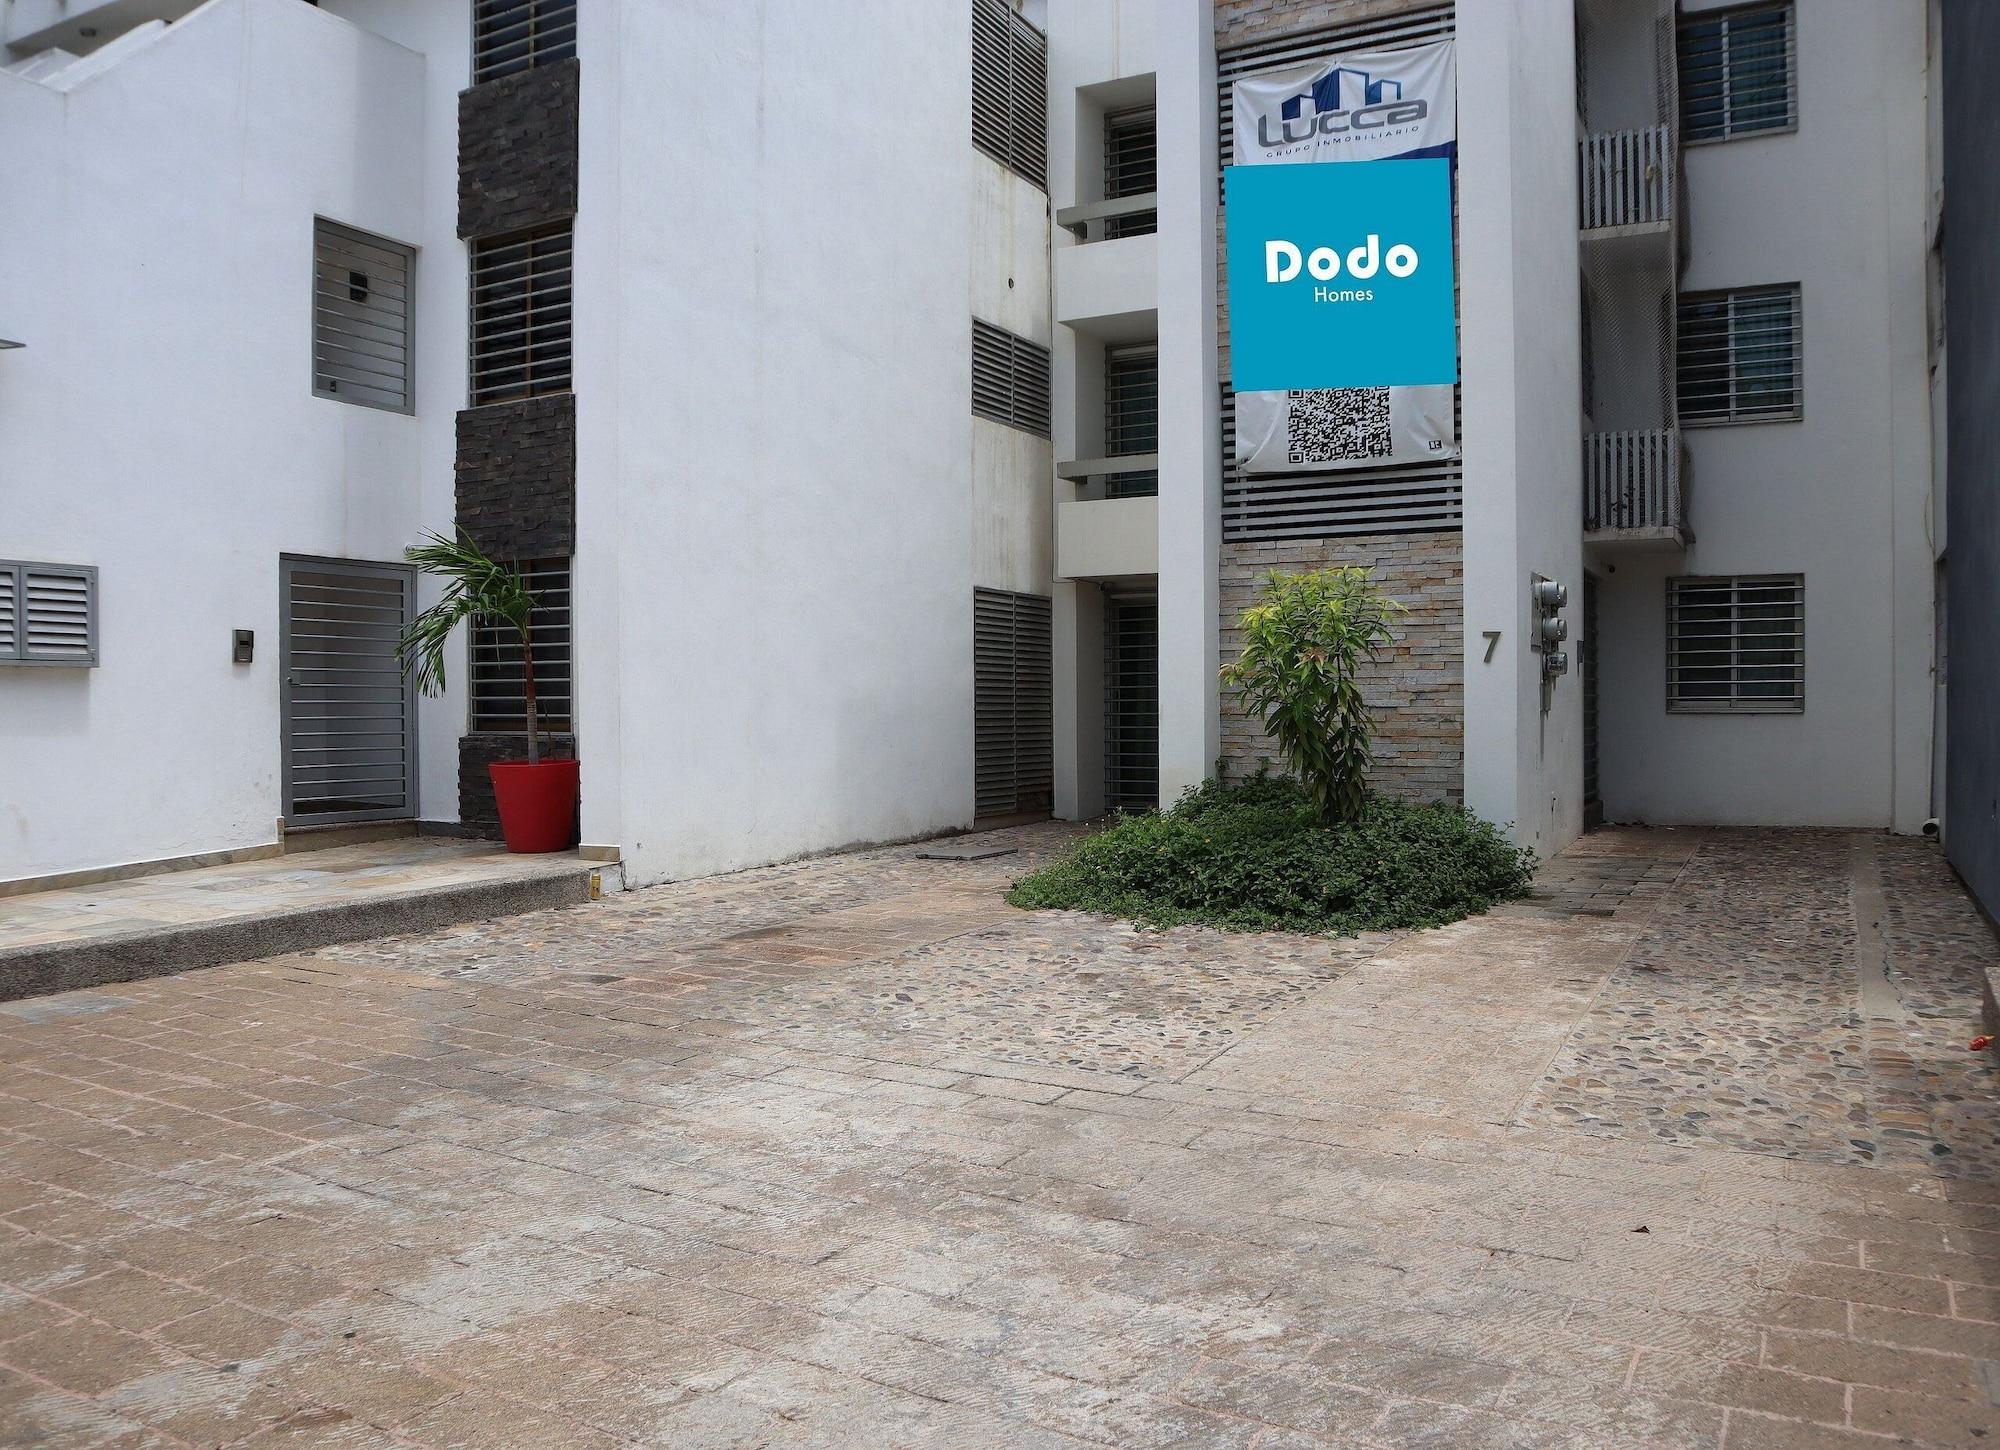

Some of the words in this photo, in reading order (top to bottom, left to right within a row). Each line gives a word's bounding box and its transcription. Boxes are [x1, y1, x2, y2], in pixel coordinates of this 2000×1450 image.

[1266, 145, 1311, 158] GRUPO
[1317, 125, 1420, 147] INMOBILIARIO
[1482, 631, 1502, 663] 7
